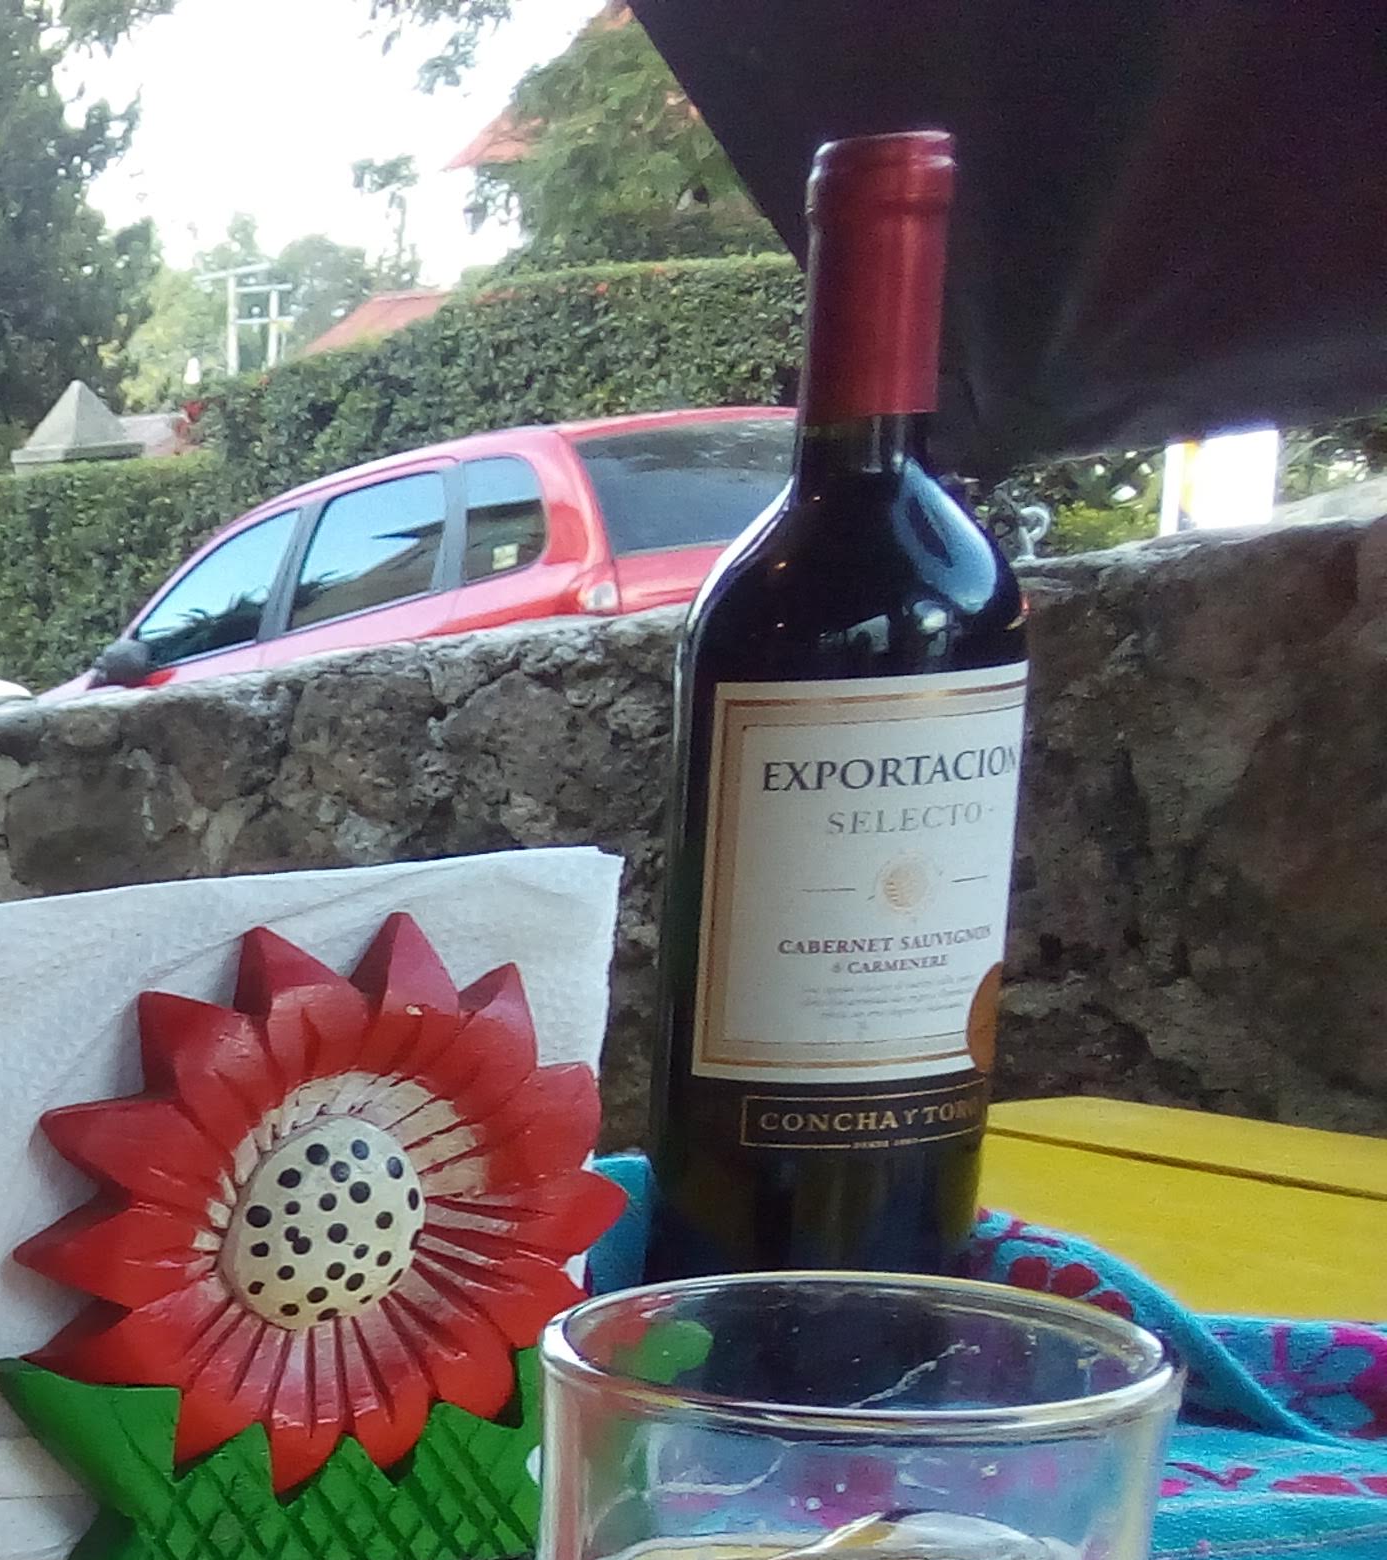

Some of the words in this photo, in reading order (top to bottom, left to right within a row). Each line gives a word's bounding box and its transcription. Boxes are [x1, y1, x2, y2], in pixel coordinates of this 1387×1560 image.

[827, 801, 982, 835] SELECTO
[779, 936, 895, 955] CABERNET
[760, 1110, 898, 1131] CONCHA
